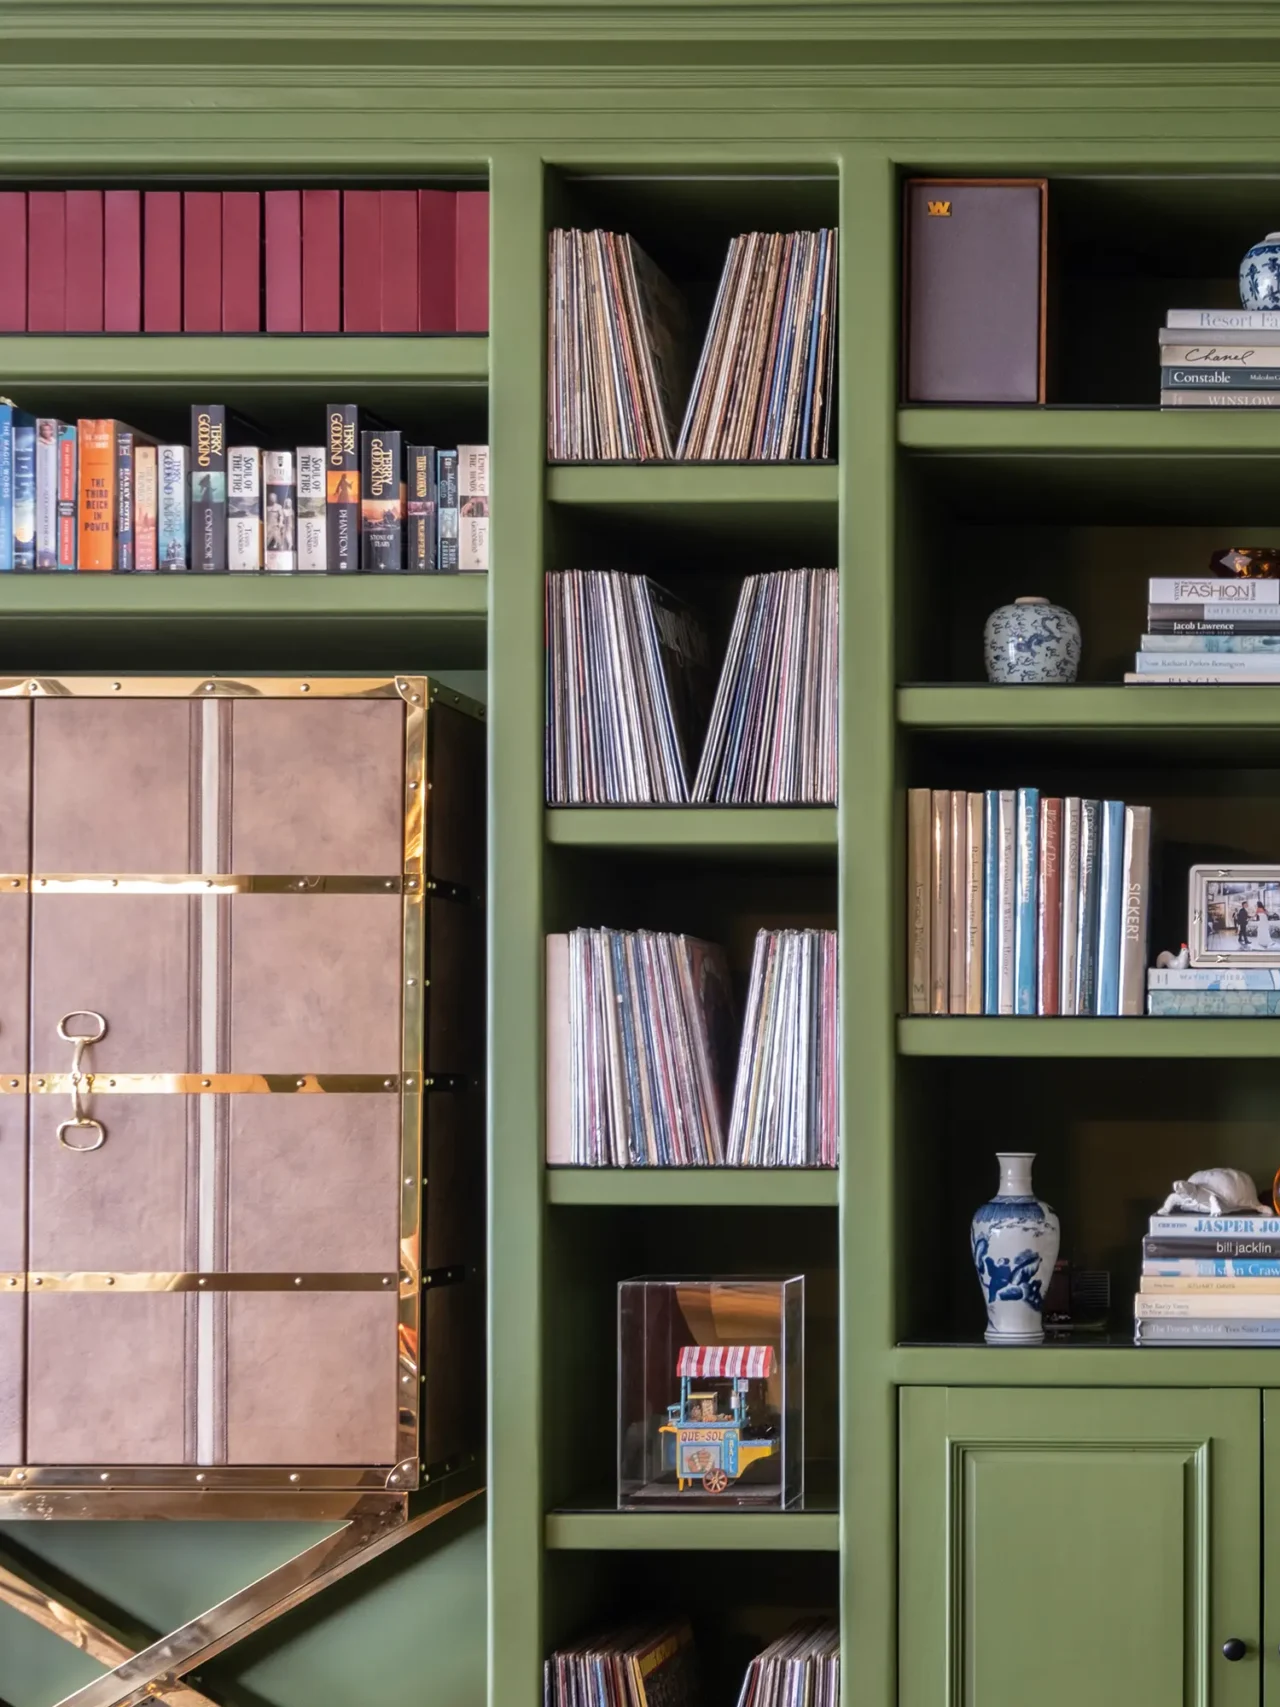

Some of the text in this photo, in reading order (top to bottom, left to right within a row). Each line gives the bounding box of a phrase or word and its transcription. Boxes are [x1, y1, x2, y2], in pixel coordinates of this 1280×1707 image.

[1199, 312, 1253, 328] Resort
[1184, 348, 1256, 365] Chanel
[1173, 371, 1231, 384] Constable
[197, 413, 211, 467] GOODKIND
[210, 423, 222, 456] TERRY
[330, 412, 343, 466] GOODKIND
[343, 422, 355, 456] TERRY
[1, 422, 10, 499] THE MAGIC WORDS
[232, 454, 242, 494] THE FIRE
[243, 456, 255, 492] SOUL OF
[300, 454, 311, 494] THE FIRE
[312, 457, 323, 492] SOUL OF
[370, 438, 383, 496] GOODKIND
[381, 449, 393, 486] TERRY
[85, 489, 109, 499] THIRD
[90, 478, 105, 488] THE
[85, 500, 109, 510] REICH
[93, 511, 102, 520] IN
[84, 522, 110, 532] POWER
[204, 508, 213, 559] CONFESSOR
[339, 509, 348, 557] PHANTOM
[1180, 585, 1250, 598] FASHION
[1173, 622, 1235, 631] Jacob Lawrence
[1046, 809, 1057, 838] Wright
[1047, 839, 1057, 850] of
[1126, 883, 1141, 942] SICKERT
[1193, 1219, 1255, 1233] JASPER
[1216, 1241, 1272, 1256] bill jacklin
[680, 1431, 724, 1442] QUE-SOL
